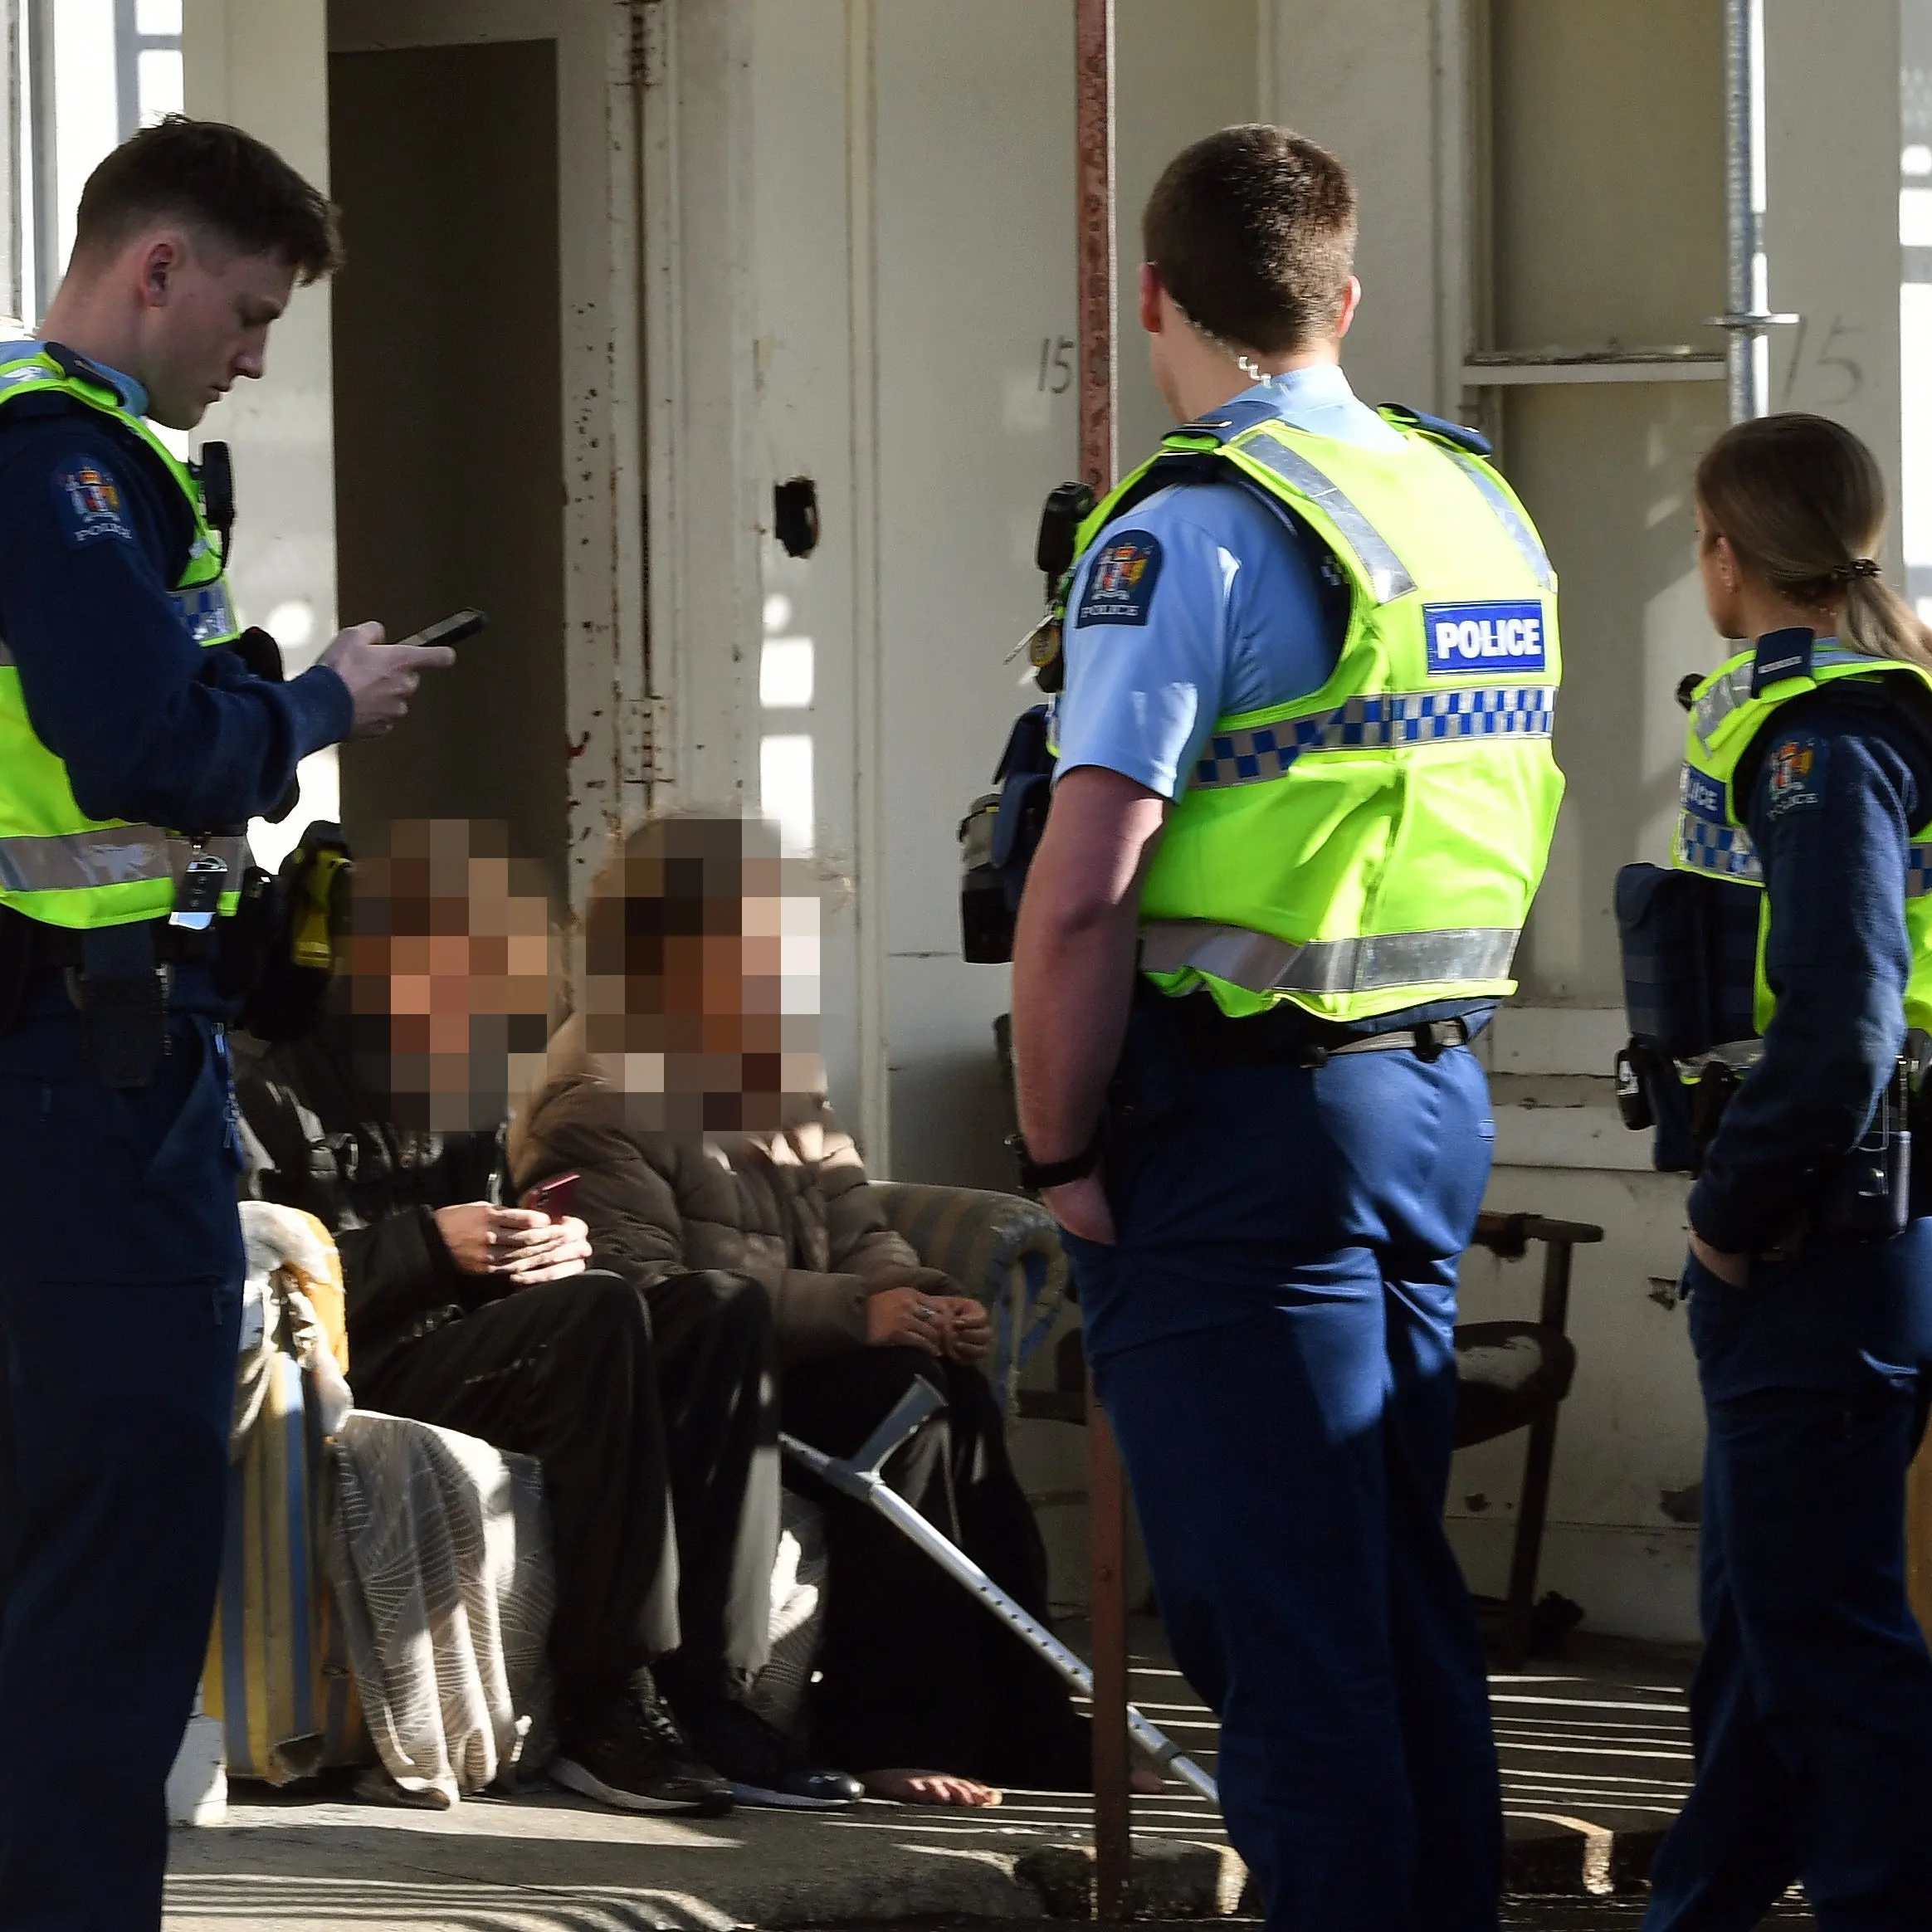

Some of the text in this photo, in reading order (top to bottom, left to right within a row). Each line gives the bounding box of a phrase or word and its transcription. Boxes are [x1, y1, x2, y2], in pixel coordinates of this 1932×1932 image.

[1038, 335, 1074, 394] 15
[1782, 311, 1869, 405] 15
[1081, 604, 1139, 618] POLICE
[1435, 618, 1541, 659] POLICE
